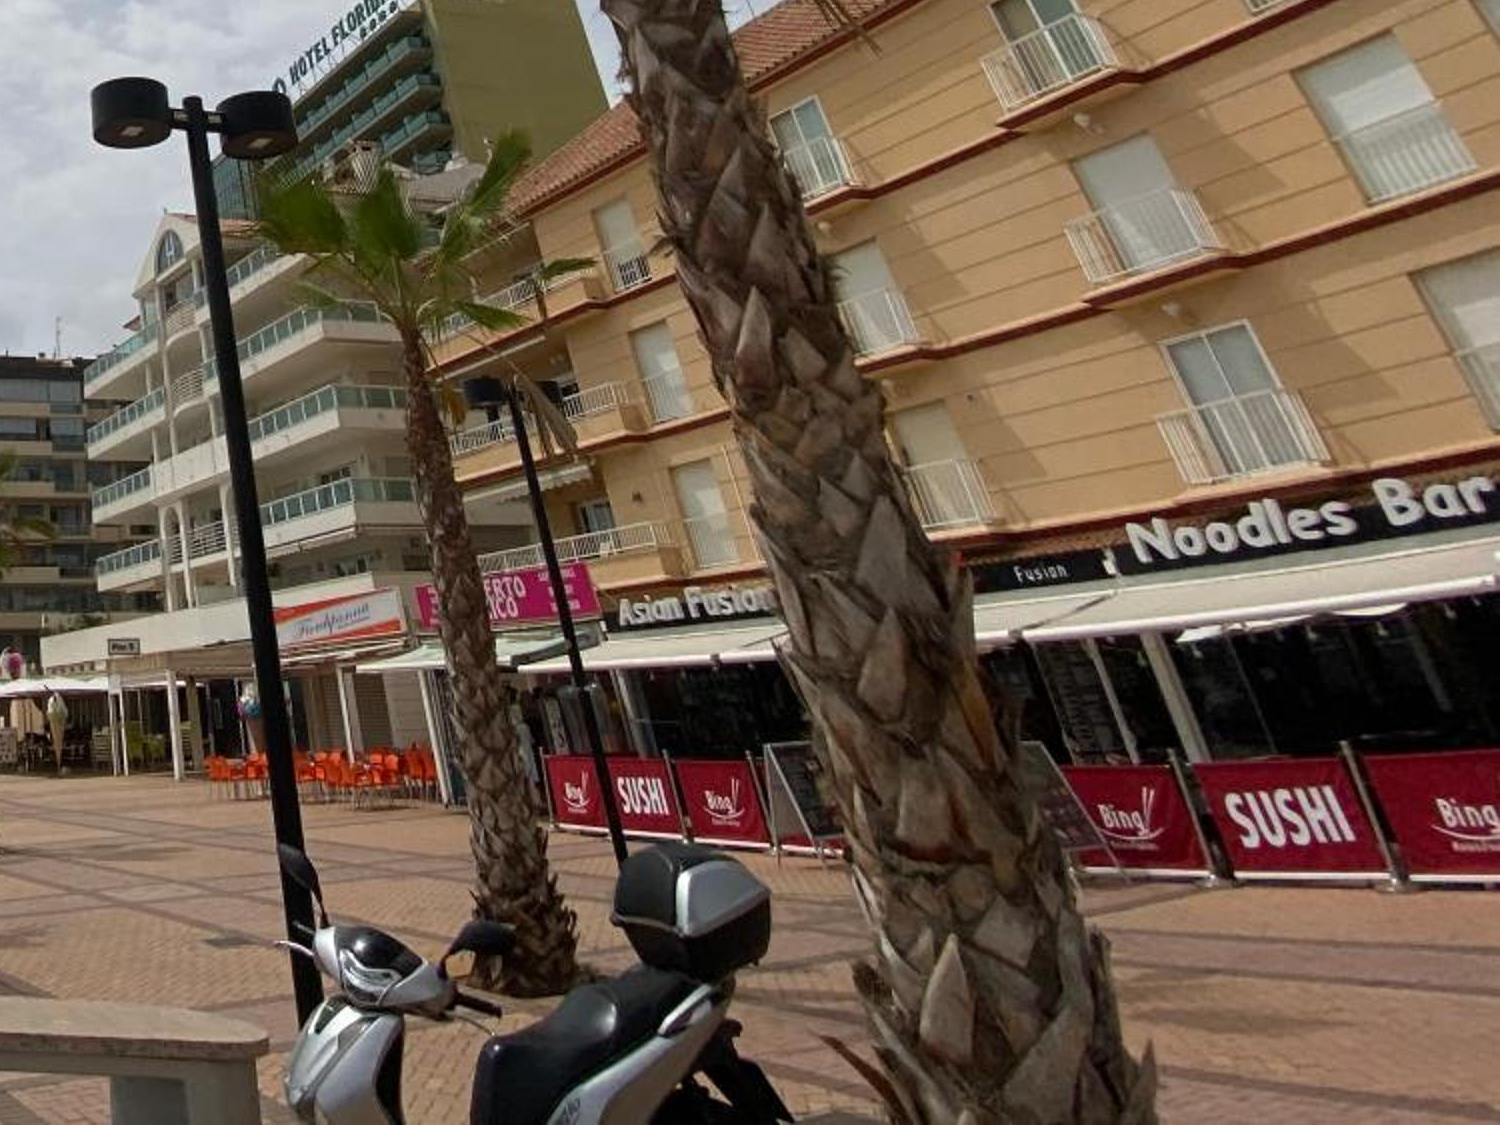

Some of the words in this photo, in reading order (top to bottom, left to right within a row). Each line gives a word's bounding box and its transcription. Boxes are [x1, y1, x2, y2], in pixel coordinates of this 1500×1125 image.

[289, 37, 331, 85] HOTEL
[1125, 497, 1357, 564] Noodles
[1372, 477, 1496, 526] Bar
[484, 576, 527, 598] ERTO
[1013, 563, 1067, 583] Fusion
[487, 595, 519, 619] ICO
[619, 595, 685, 626] Asian
[683, 586, 775, 619] Fusion
[617, 777, 669, 815] SUSHI
[1097, 803, 1148, 836] Bing
[1224, 785, 1356, 848] SUSHI
